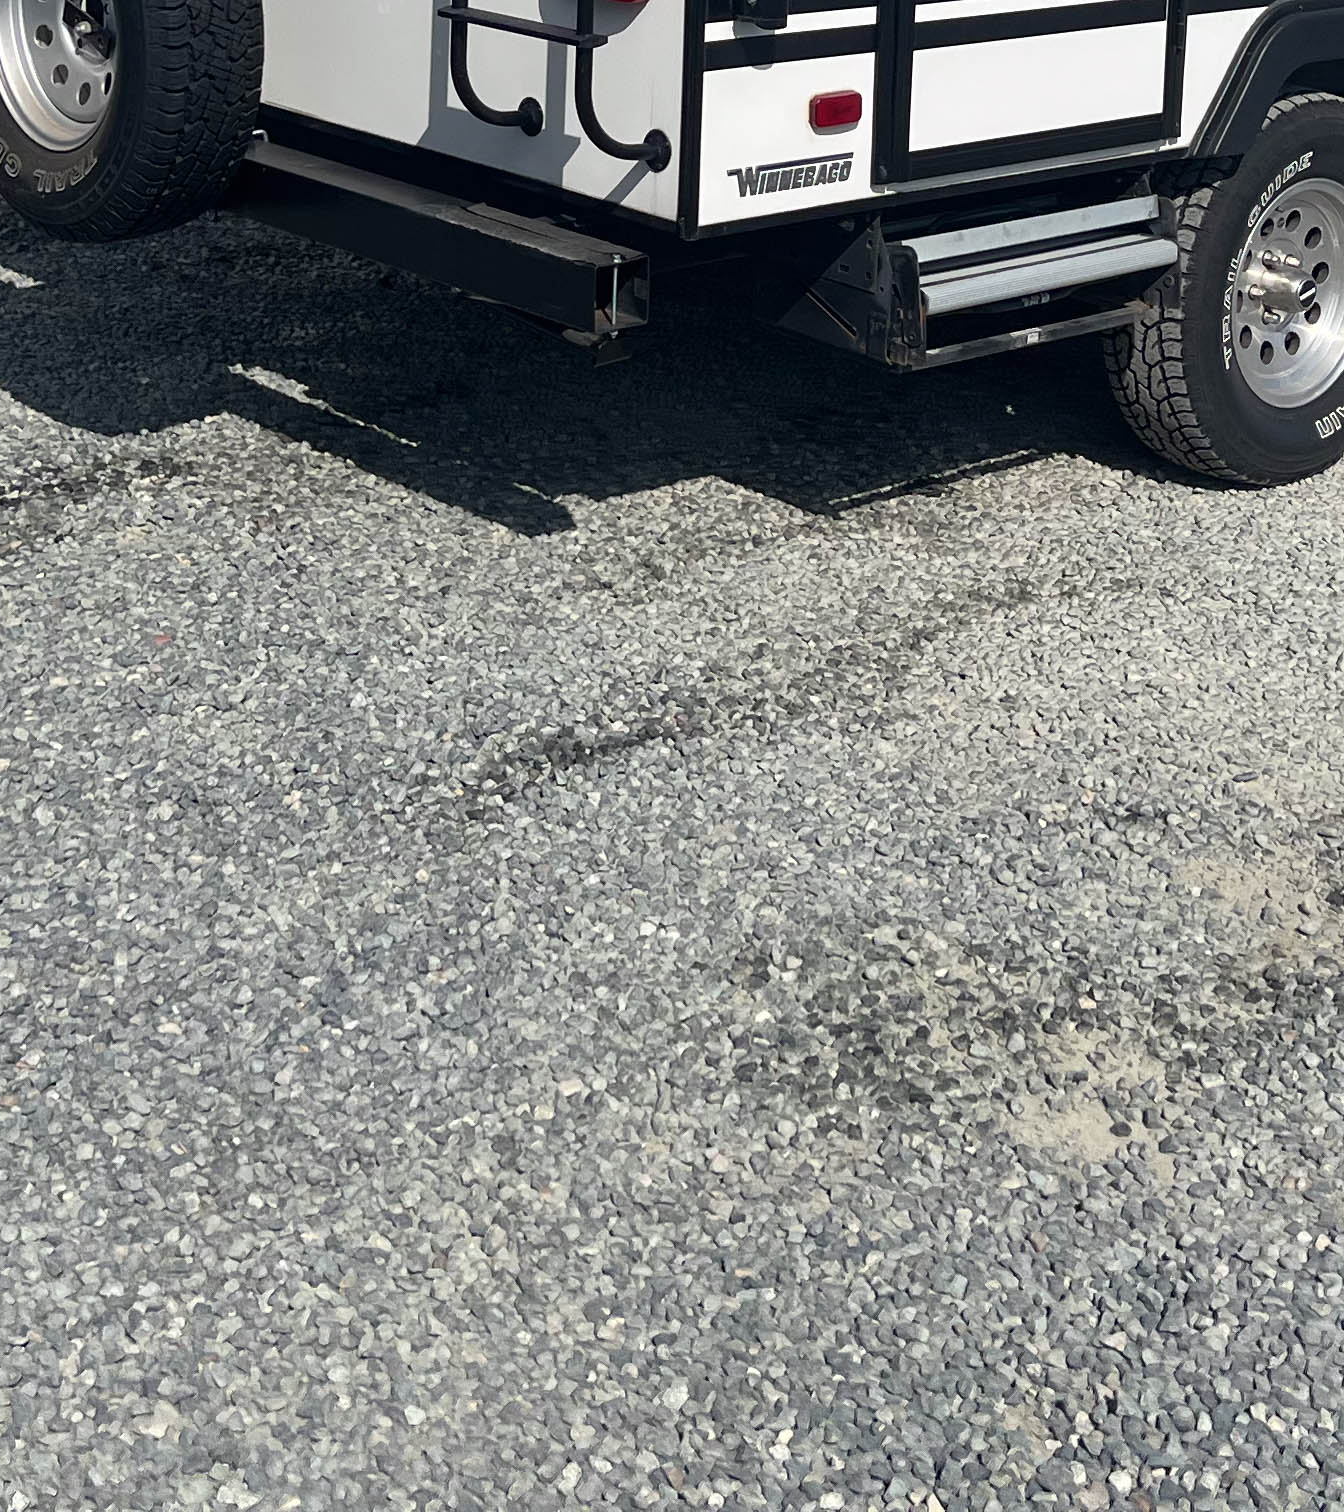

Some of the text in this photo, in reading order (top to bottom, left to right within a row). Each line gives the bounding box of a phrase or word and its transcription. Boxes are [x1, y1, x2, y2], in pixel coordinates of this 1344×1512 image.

[33, 149, 99, 194] TRAIL
[726, 157, 853, 199] WINNEBAGO
[1220, 151, 1314, 371] TRAIL GUIDE
